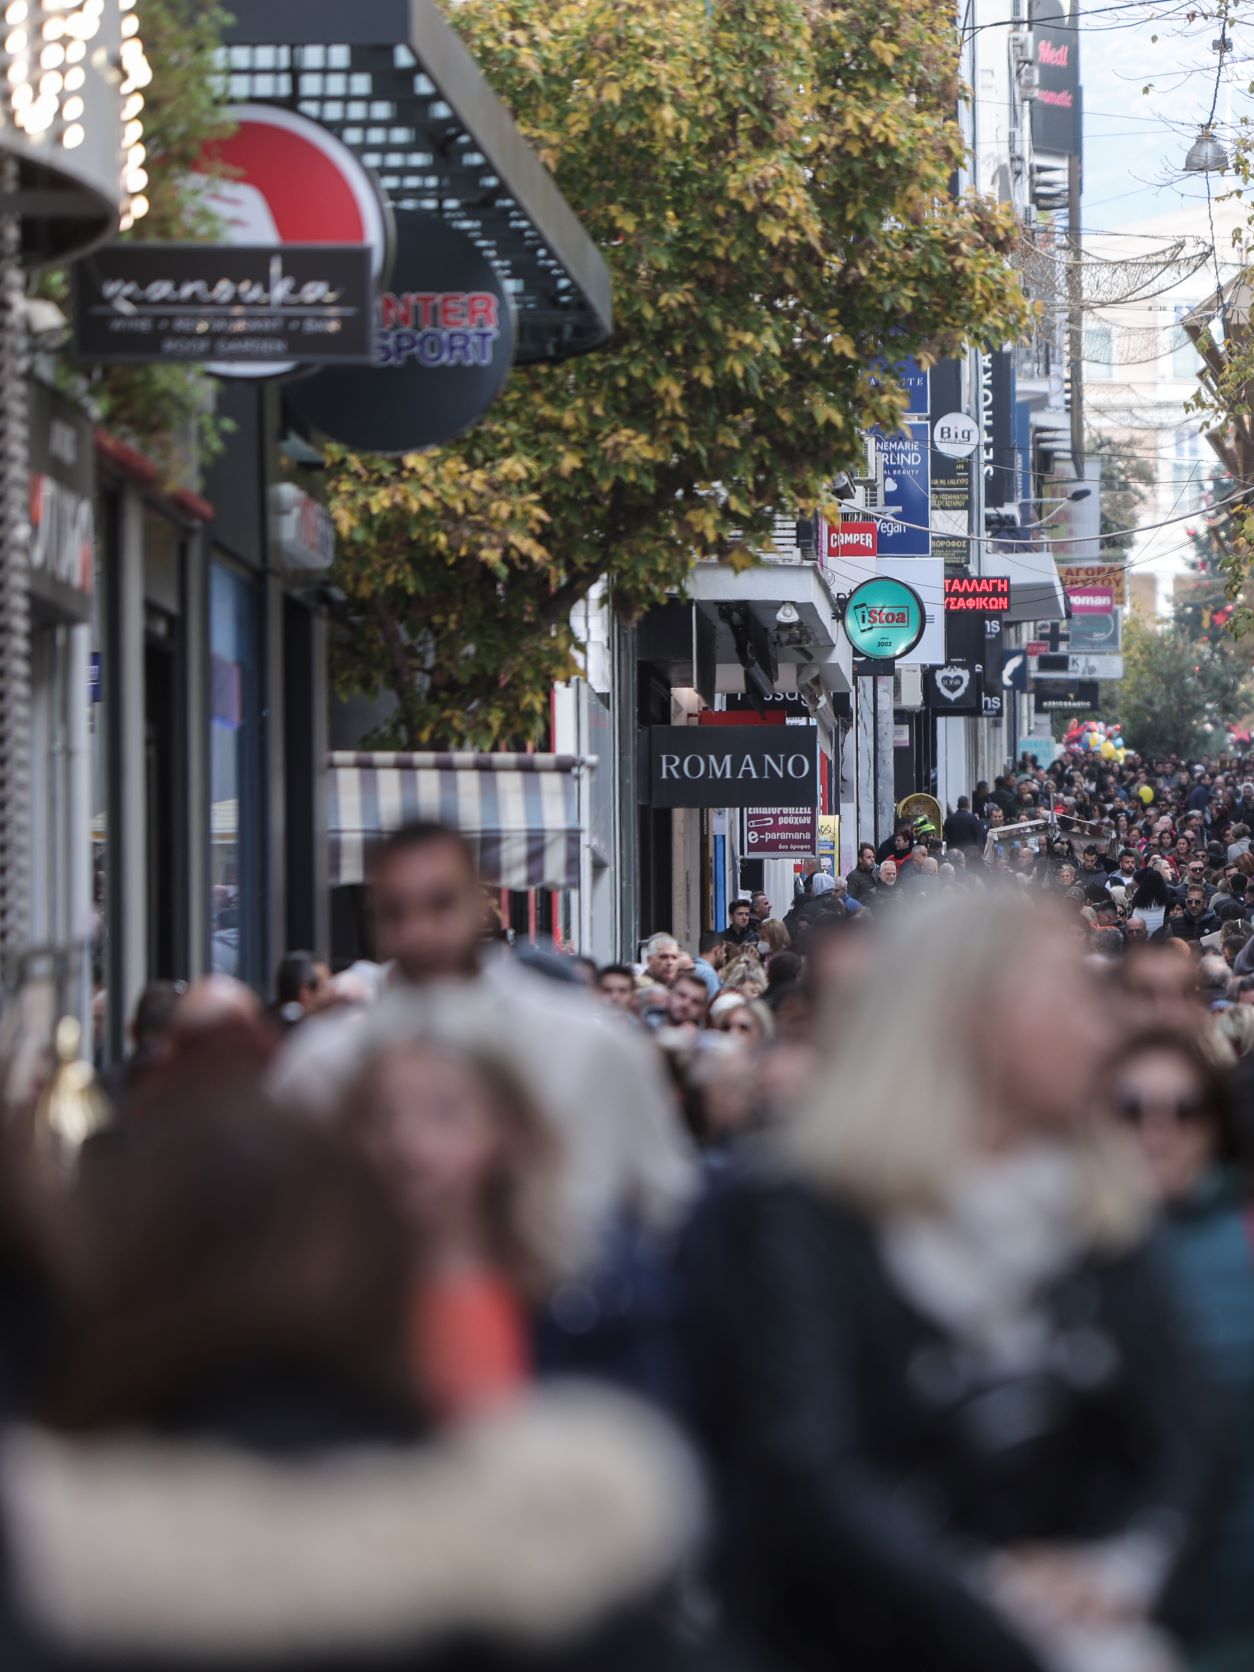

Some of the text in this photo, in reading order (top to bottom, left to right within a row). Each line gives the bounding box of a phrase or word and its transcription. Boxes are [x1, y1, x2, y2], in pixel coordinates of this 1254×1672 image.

[376, 329, 500, 367] SPORT
[940, 426, 970, 443] Big
[830, 533, 873, 549] CAMPER
[659, 753, 810, 780] ROMANO
[748, 831, 811, 843] e-paramana
